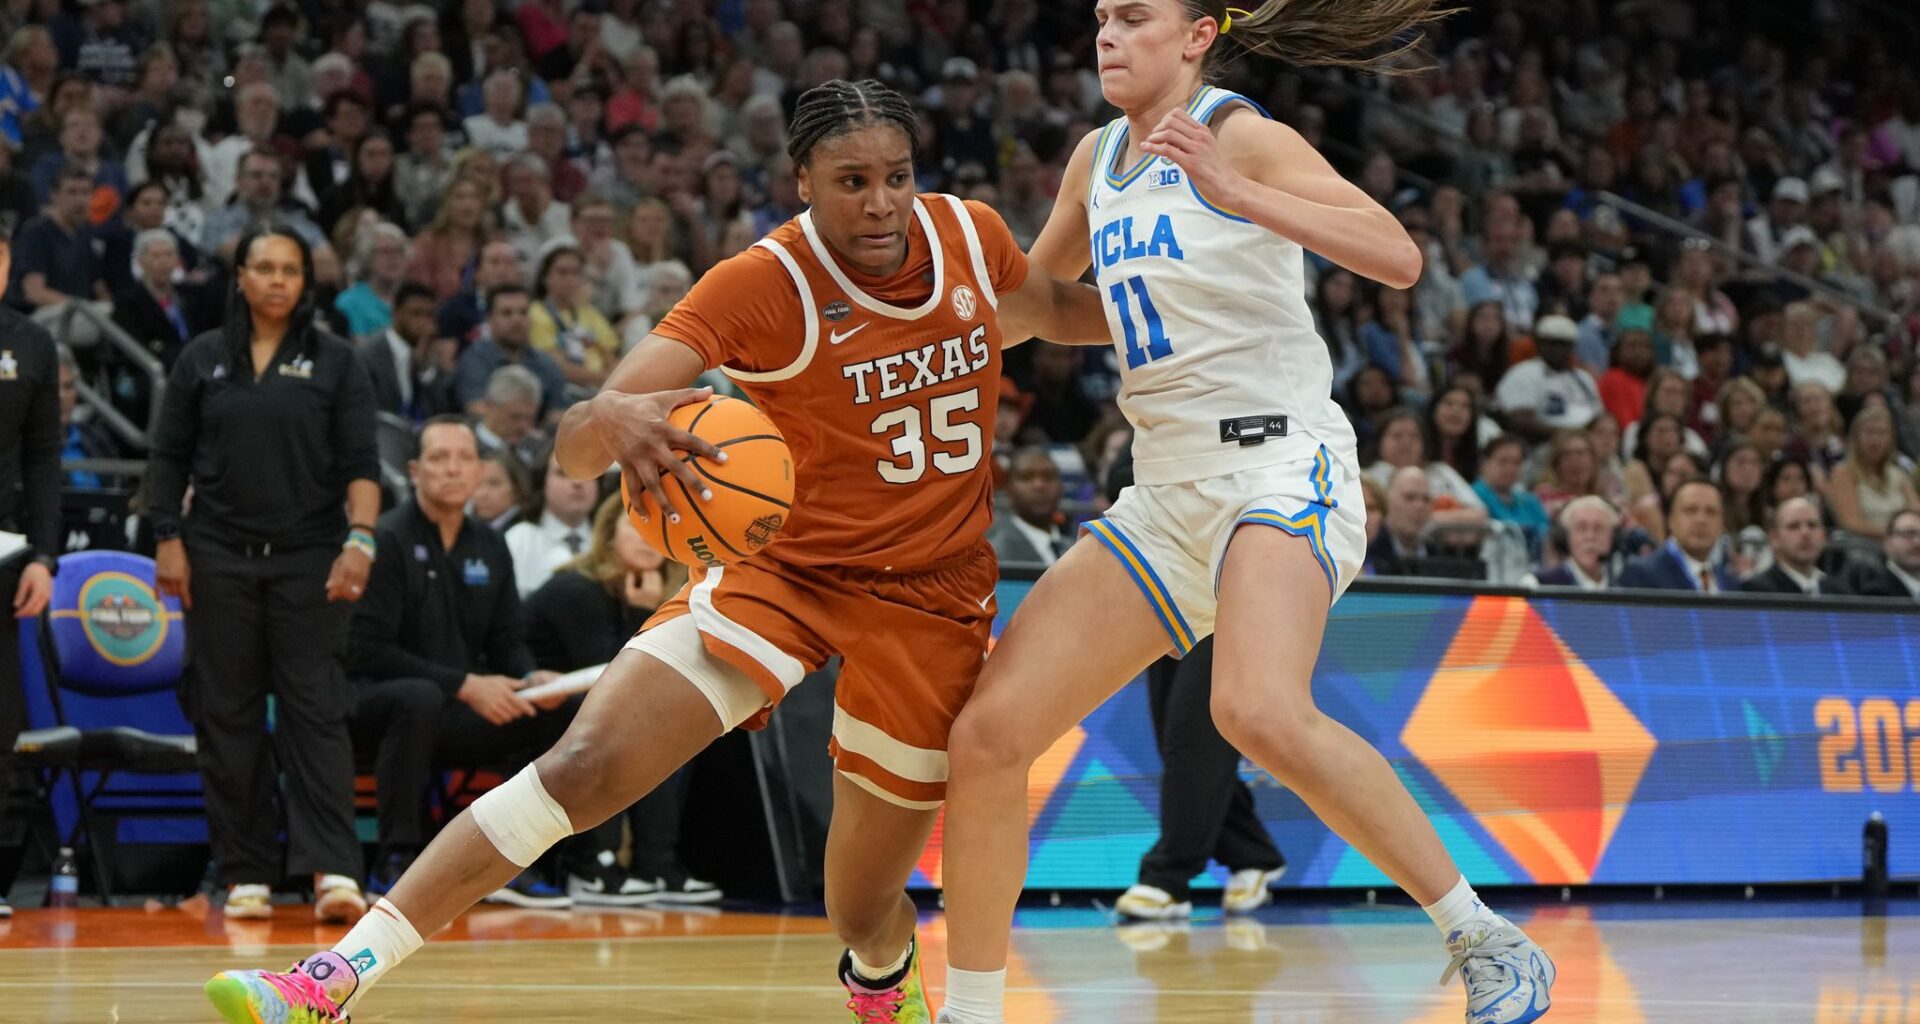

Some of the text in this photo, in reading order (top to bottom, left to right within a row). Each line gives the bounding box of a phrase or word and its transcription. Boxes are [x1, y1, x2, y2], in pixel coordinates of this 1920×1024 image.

[841, 323, 990, 404] TEXAS
[1109, 275, 1174, 370] 11
[870, 386, 983, 484] 35
[1268, 421, 1282, 430] 44
